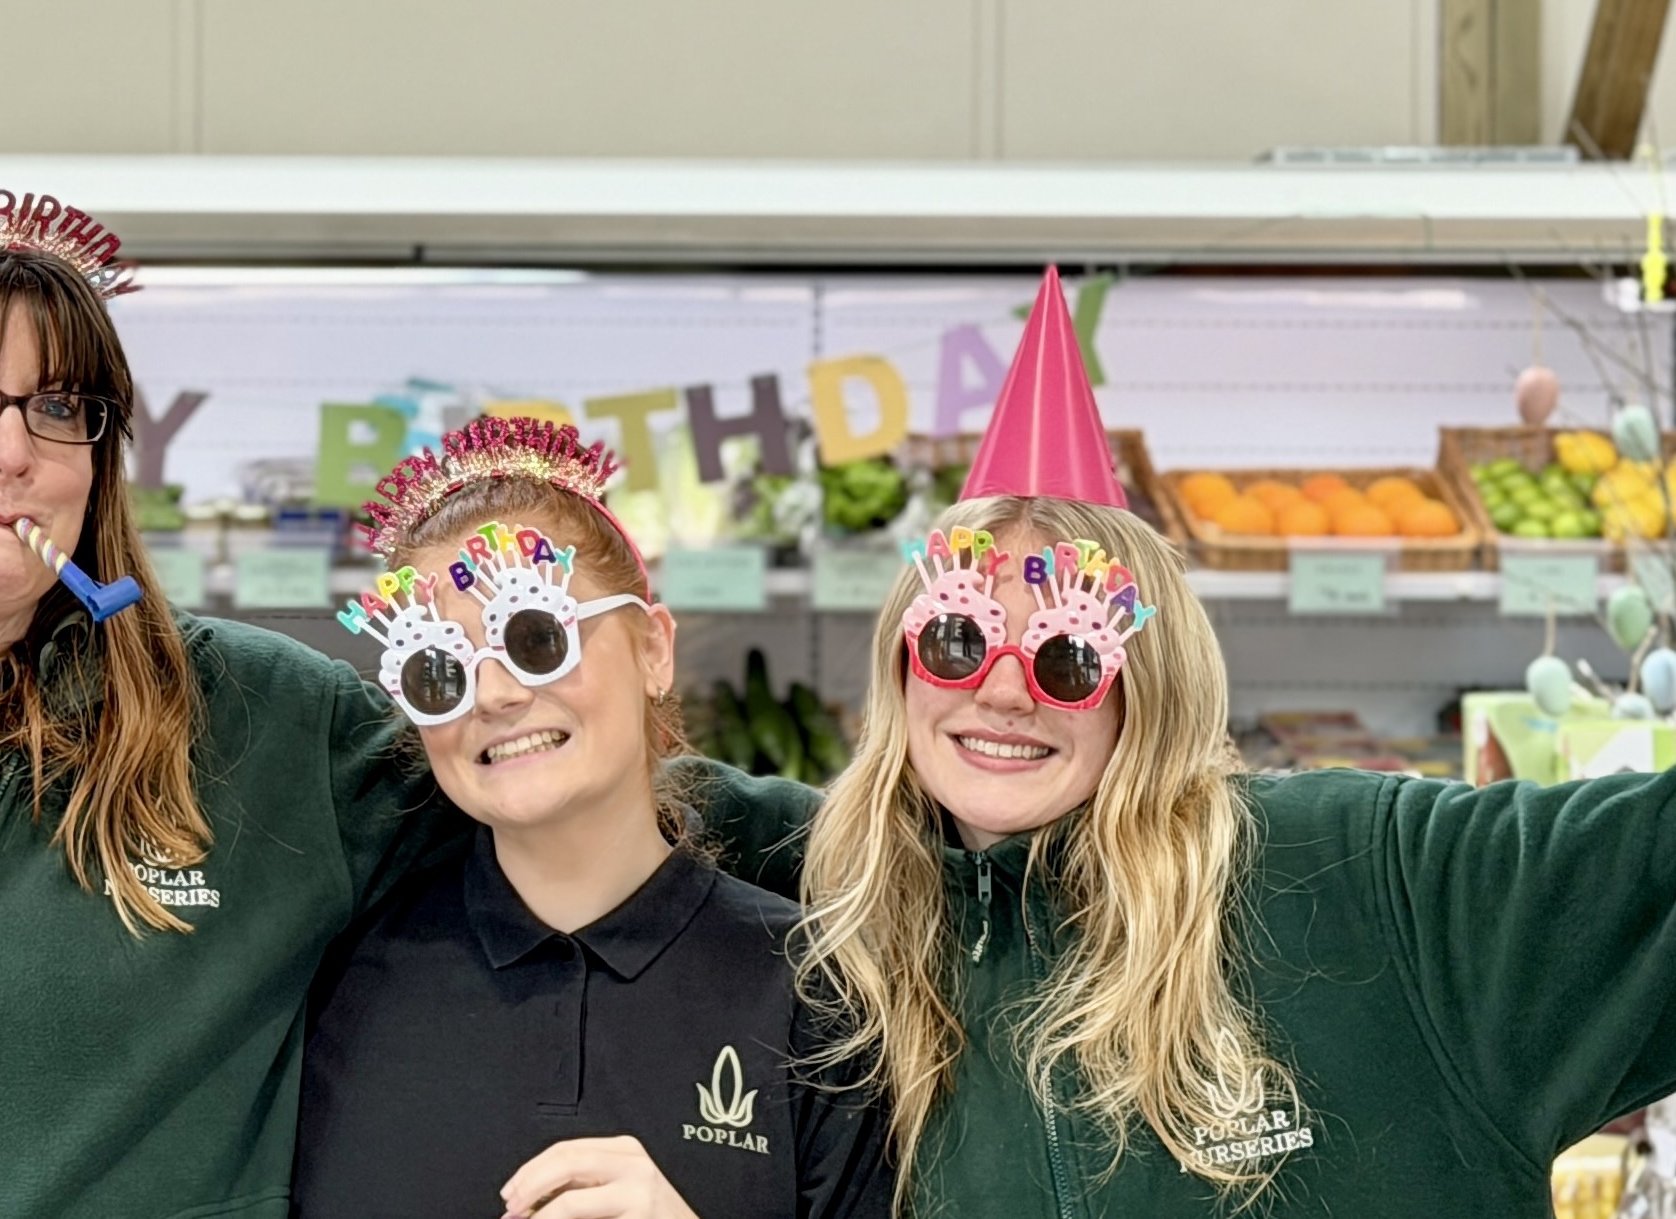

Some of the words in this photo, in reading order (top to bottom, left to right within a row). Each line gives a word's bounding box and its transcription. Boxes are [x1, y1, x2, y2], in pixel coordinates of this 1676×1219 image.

[337, 565, 438, 634] HAPPY
[448, 521, 576, 591] BIRTHDAY
[901, 526, 1009, 576] HAPPY
[1023, 539, 1157, 631] BIRTHDAY
[128, 863, 205, 886] OPLAR
[104, 879, 220, 908] NSERIES
[682, 1124, 771, 1155] POPLAR
[1193, 1110, 1290, 1145] POPLAR
[1180, 1127, 1314, 1173] URSERIES
